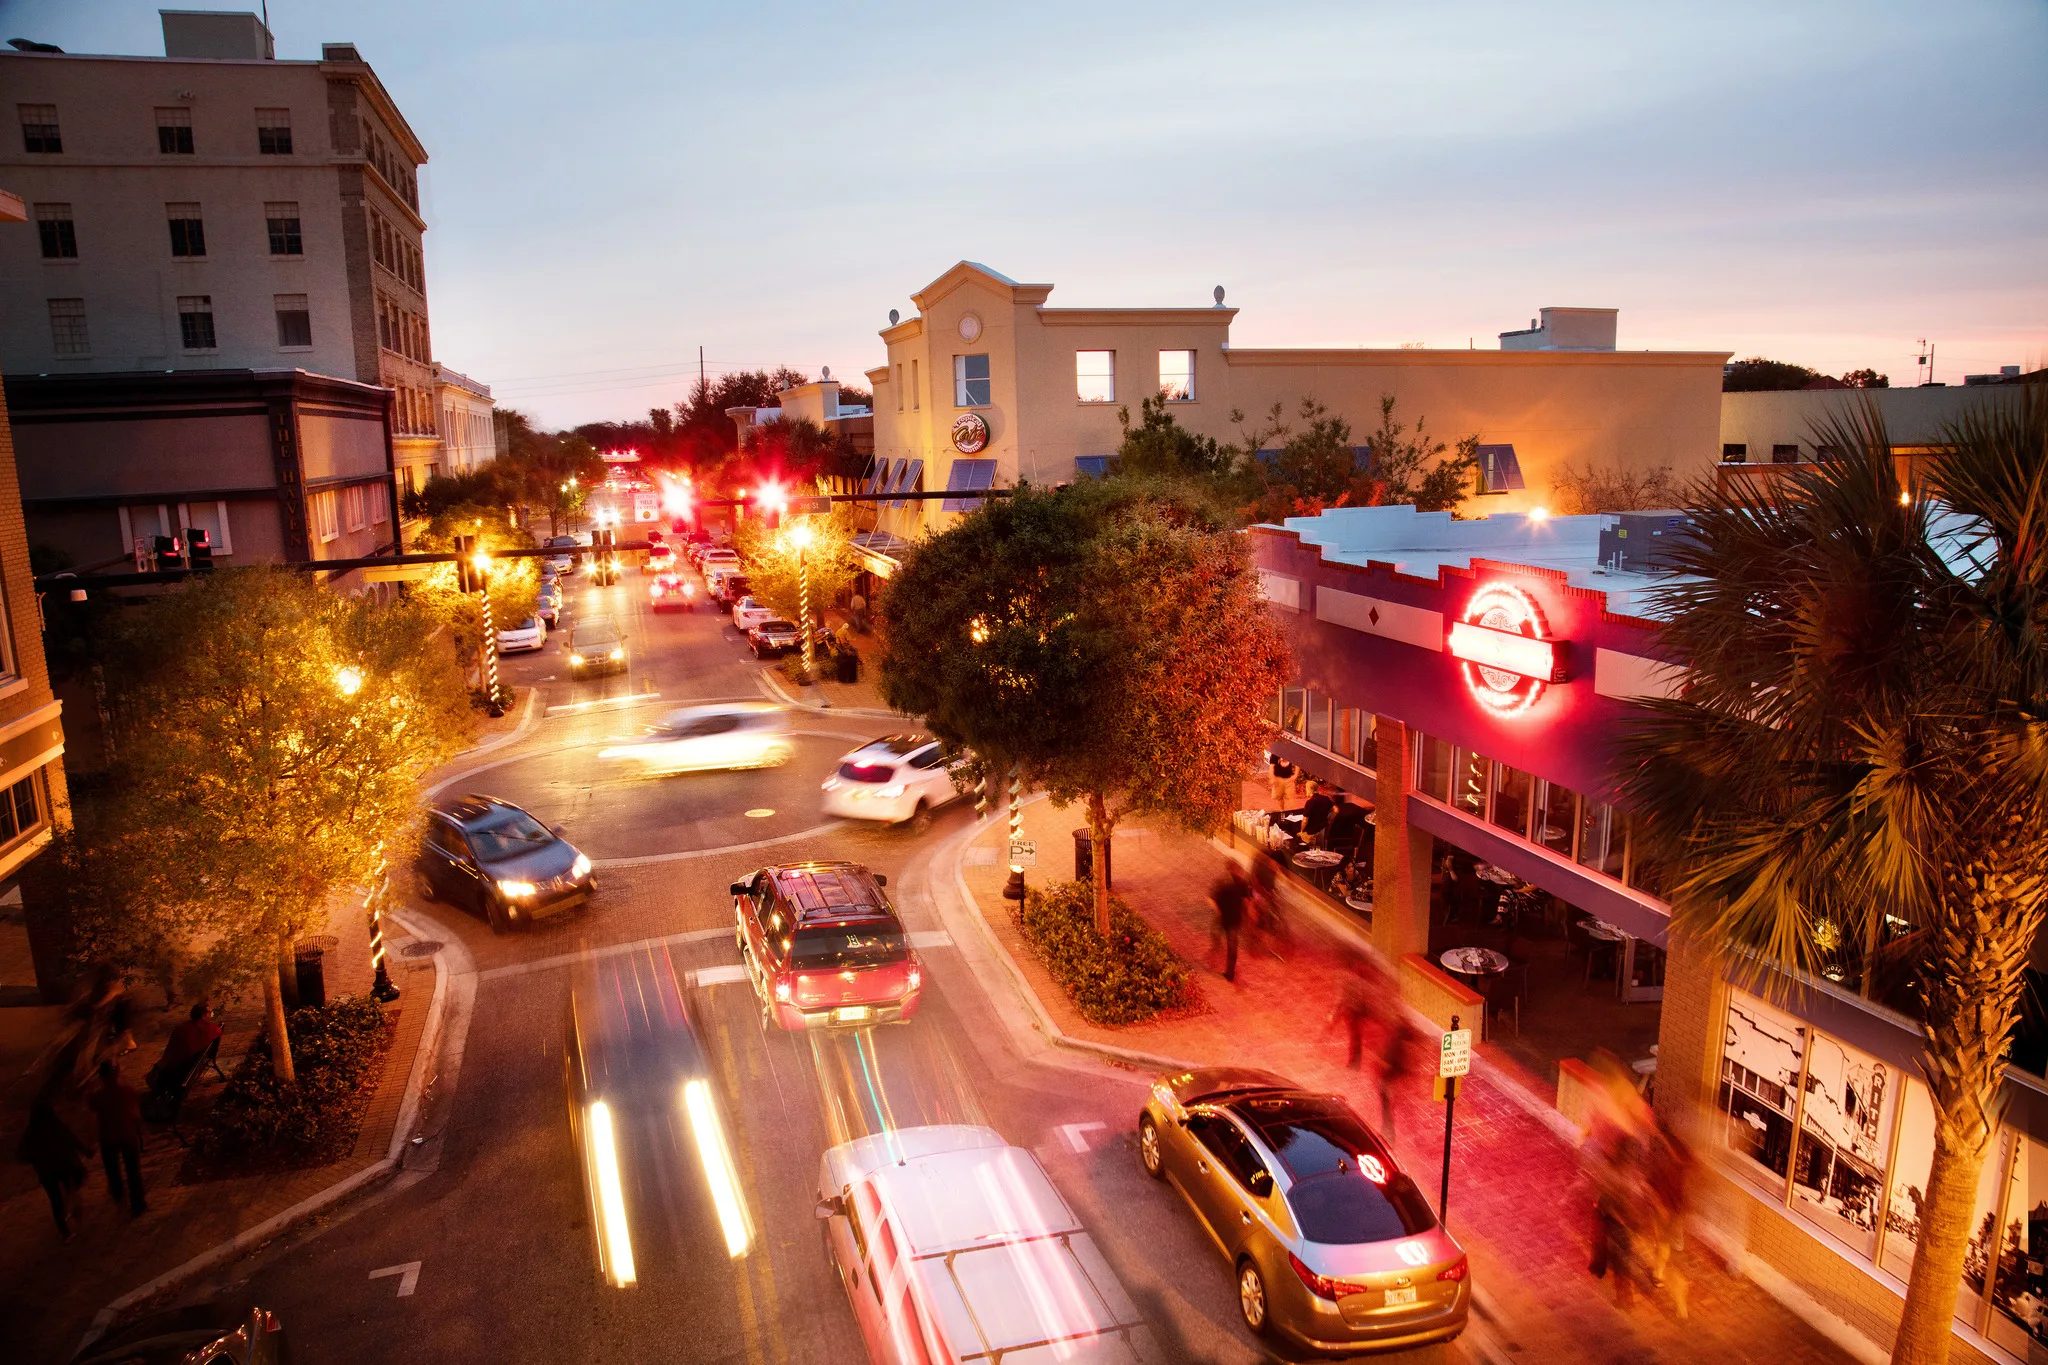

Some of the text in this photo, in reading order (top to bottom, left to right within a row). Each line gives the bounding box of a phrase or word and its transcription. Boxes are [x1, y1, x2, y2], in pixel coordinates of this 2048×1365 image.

[953, 415, 984, 429] Tropical
[955, 441, 984, 453] Smoothie
[276, 412, 303, 549] THE HAVEN
[1821, 965, 1842, 976] GOOSE
[1444, 1036, 1451, 1049] 2
[1867, 1074, 1883, 1138] RITZ
